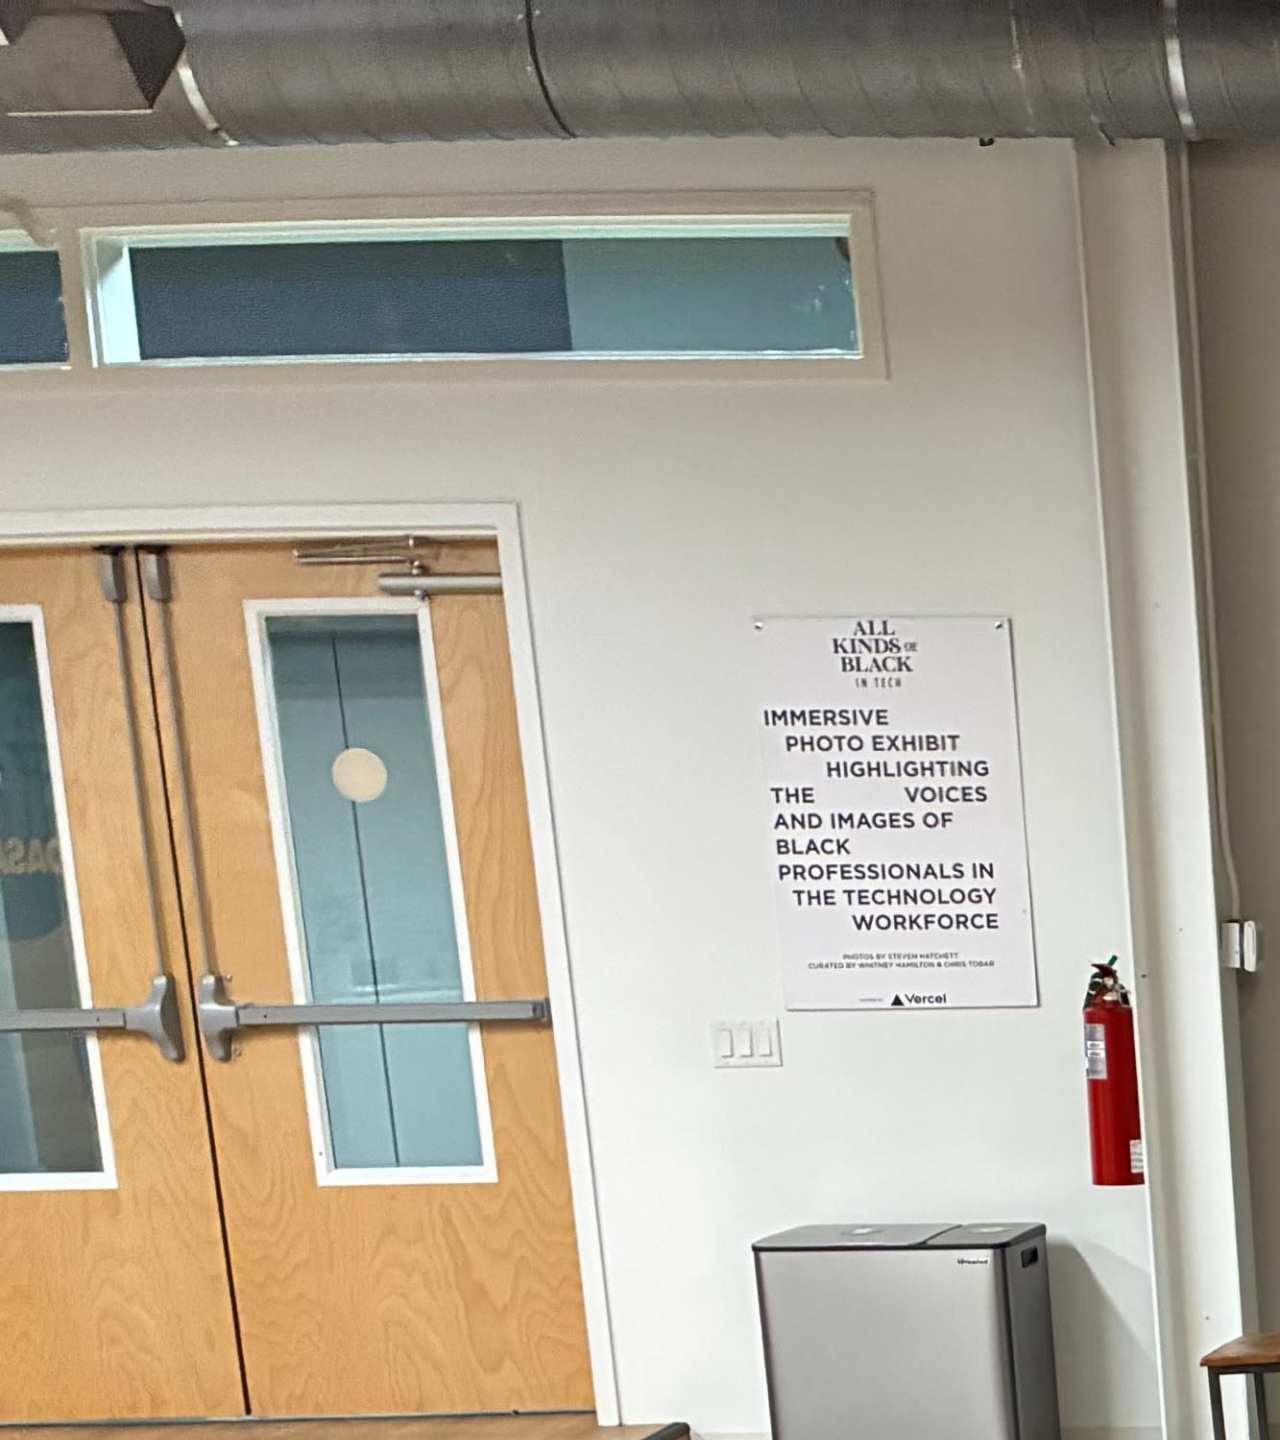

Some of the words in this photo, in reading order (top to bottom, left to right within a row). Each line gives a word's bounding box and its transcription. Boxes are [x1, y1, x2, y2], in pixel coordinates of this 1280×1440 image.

[854, 620, 895, 636] ALL
[832, 638, 901, 654] KINDS
[841, 656, 913, 672] BLACK
[855, 677, 867, 688] IN
[874, 677, 902, 688] TECH
[764, 709, 889, 726] IMMERSIVE
[786, 735, 864, 752] PHOTO
[872, 735, 960, 752] EXHIBIT
[826, 761, 989, 778] HIGHLIGHTING
[770, 787, 815, 804] THE
[904, 786, 988, 803] VOICES
[774, 813, 823, 830] AND
[830, 813, 915, 829] IMAGES
[922, 812, 953, 828] OF
[776, 838, 850, 855] BLACK
[778, 863, 965, 881] PROFESSIONALS
[972, 863, 994, 879] IN
[792, 889, 837, 906] THE
[843, 888, 997, 905] TECHNOLOGY
[852, 913, 999, 930] WORKFORCE
[904, 993, 946, 1004] Vercel
